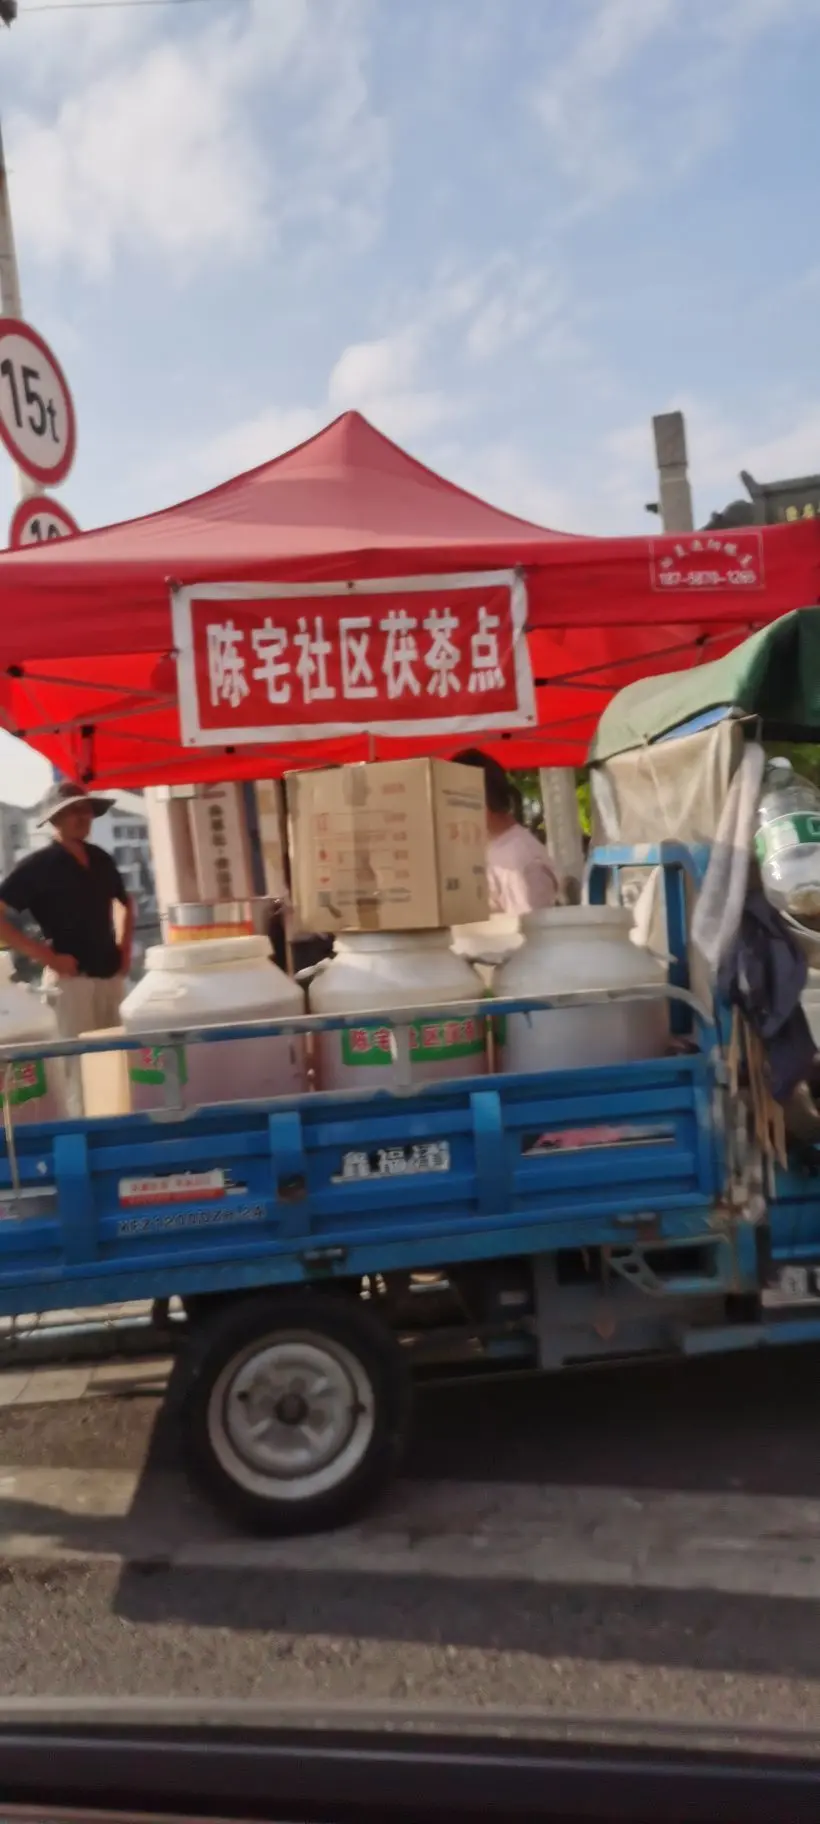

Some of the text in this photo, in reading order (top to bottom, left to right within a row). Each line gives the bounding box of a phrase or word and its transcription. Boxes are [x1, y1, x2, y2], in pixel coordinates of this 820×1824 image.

[1, 358, 59, 443] 15t
[206, 606, 505, 707] 陈宅社区茯茶点
